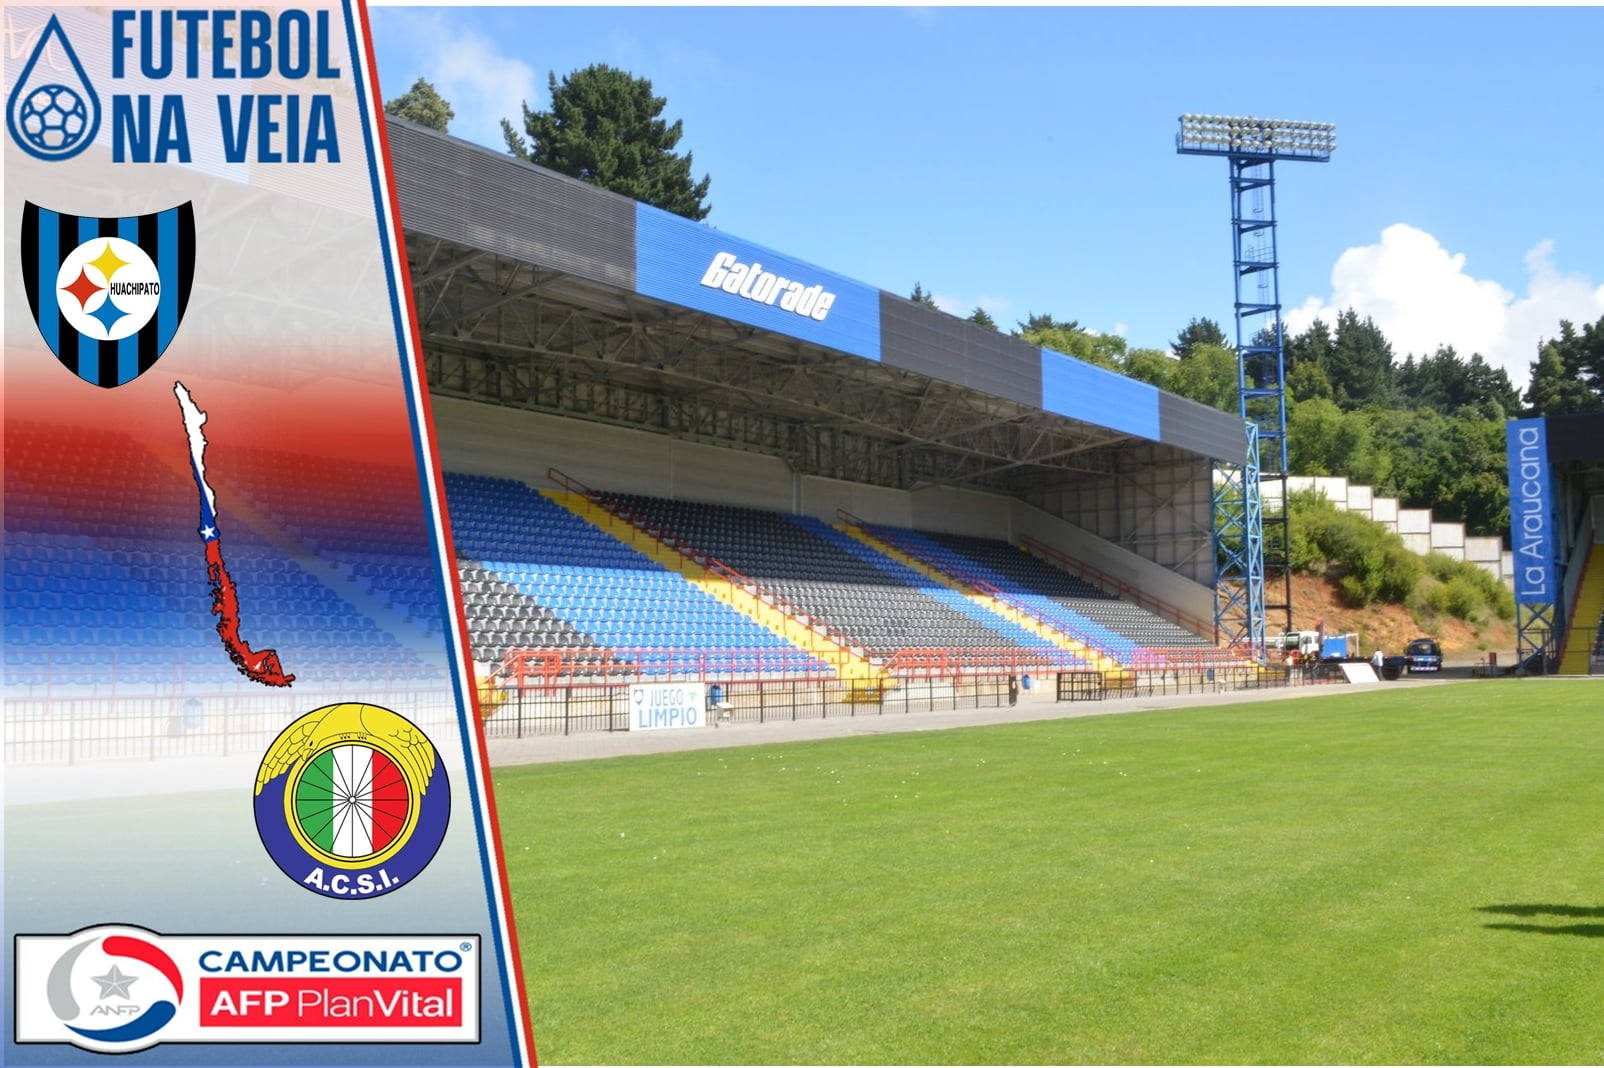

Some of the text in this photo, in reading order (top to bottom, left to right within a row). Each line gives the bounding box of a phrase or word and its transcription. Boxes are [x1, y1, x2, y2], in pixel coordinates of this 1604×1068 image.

[700, 251, 836, 321] Gatorade
[1519, 427, 1546, 596] La Araucana
[638, 706, 697, 729] LIMPIO
[650, 688, 684, 707] JUEGO
